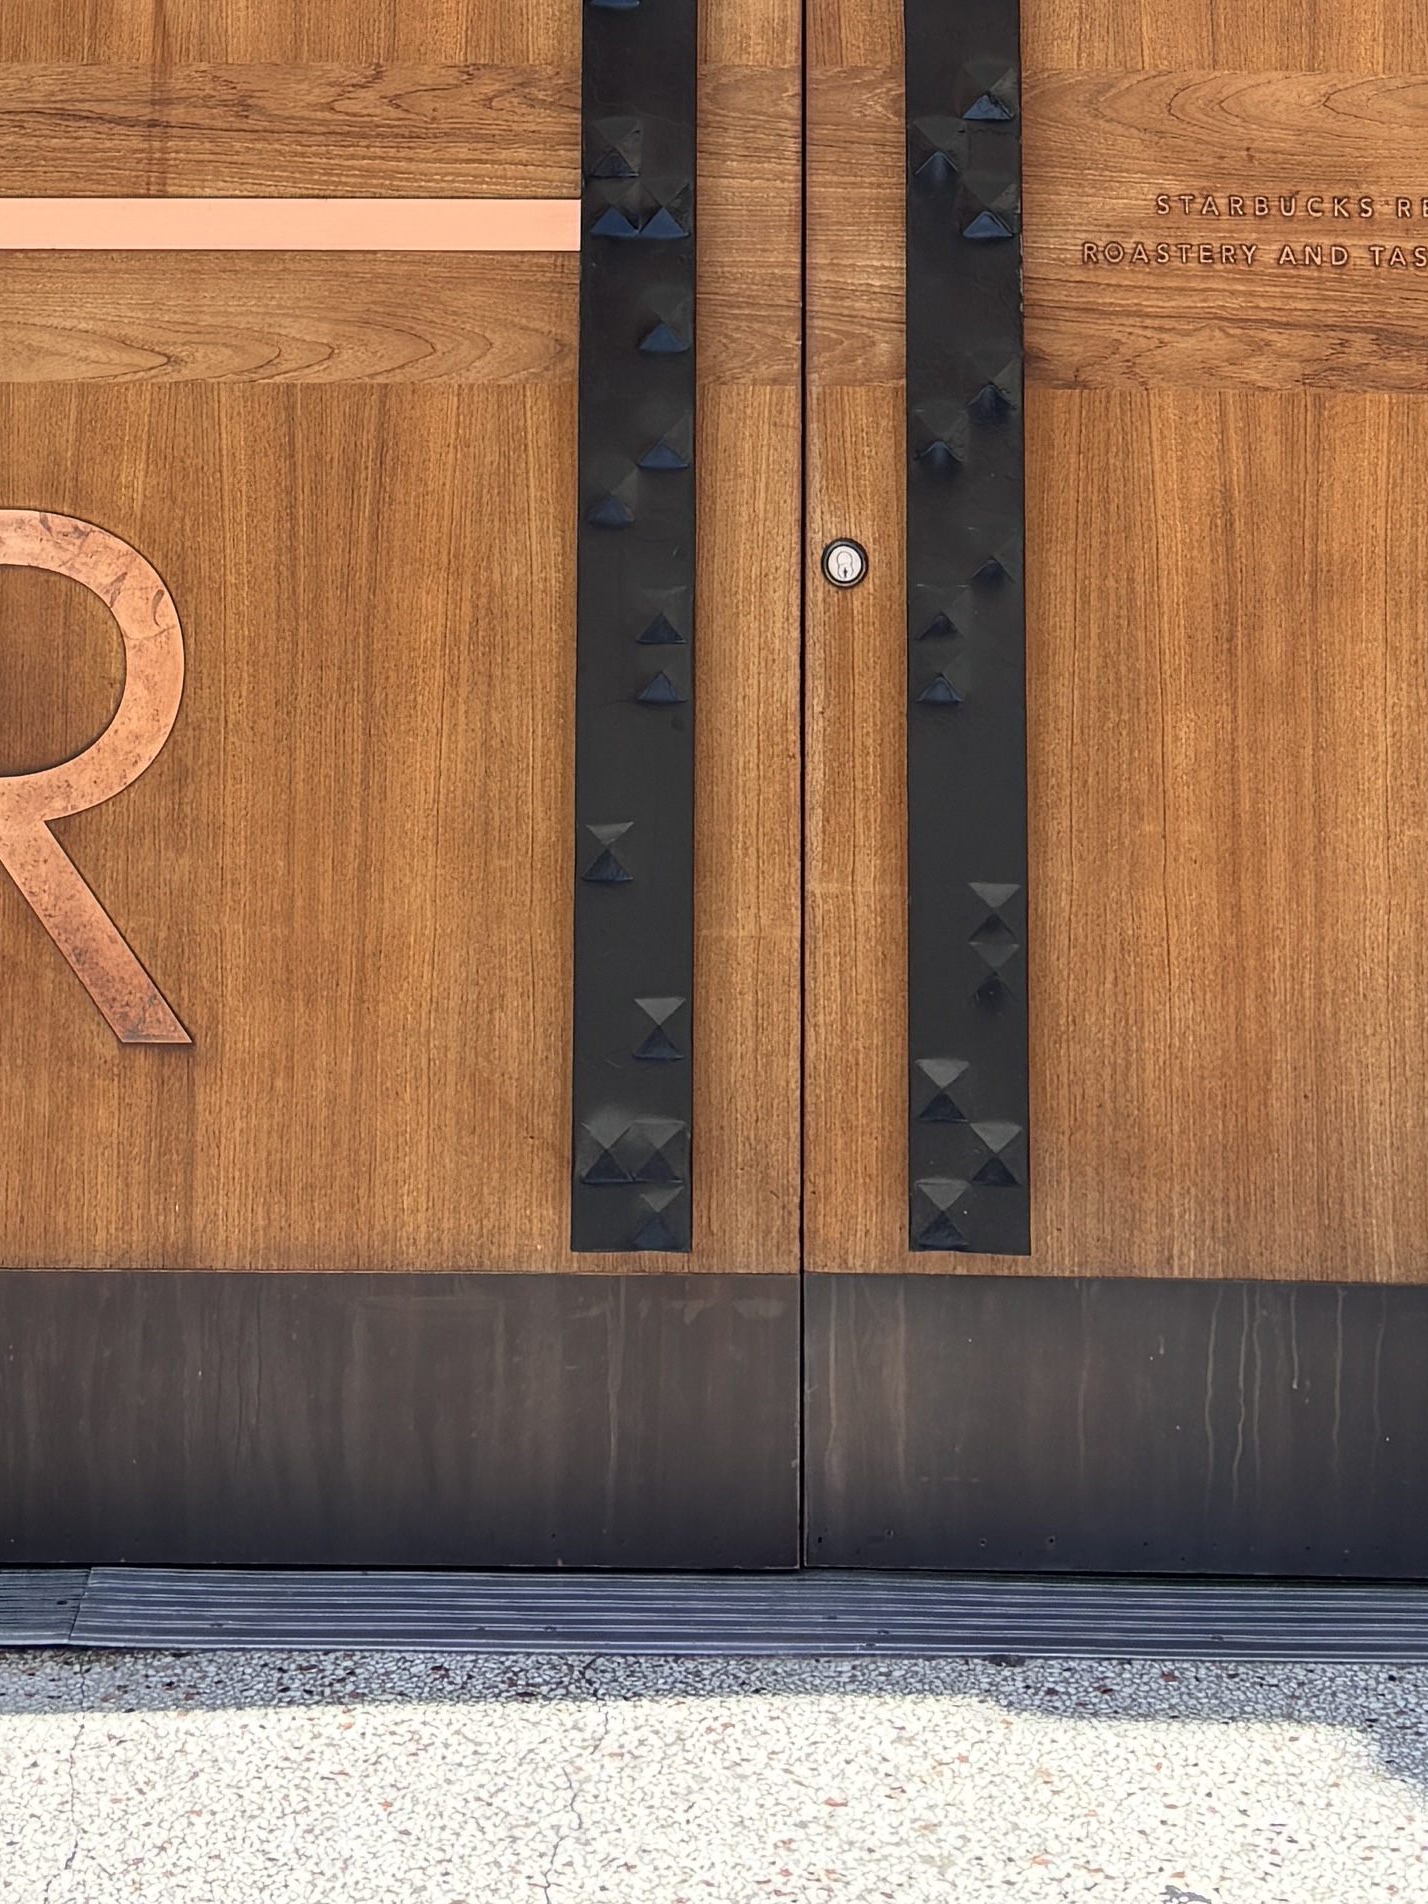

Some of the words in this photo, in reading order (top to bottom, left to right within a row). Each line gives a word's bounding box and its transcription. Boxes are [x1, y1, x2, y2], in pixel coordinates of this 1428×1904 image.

[1156, 194, 1374, 219] STARBUCKS
[1081, 242, 1257, 265] ROASTERY
[1279, 245, 1349, 268] AND
